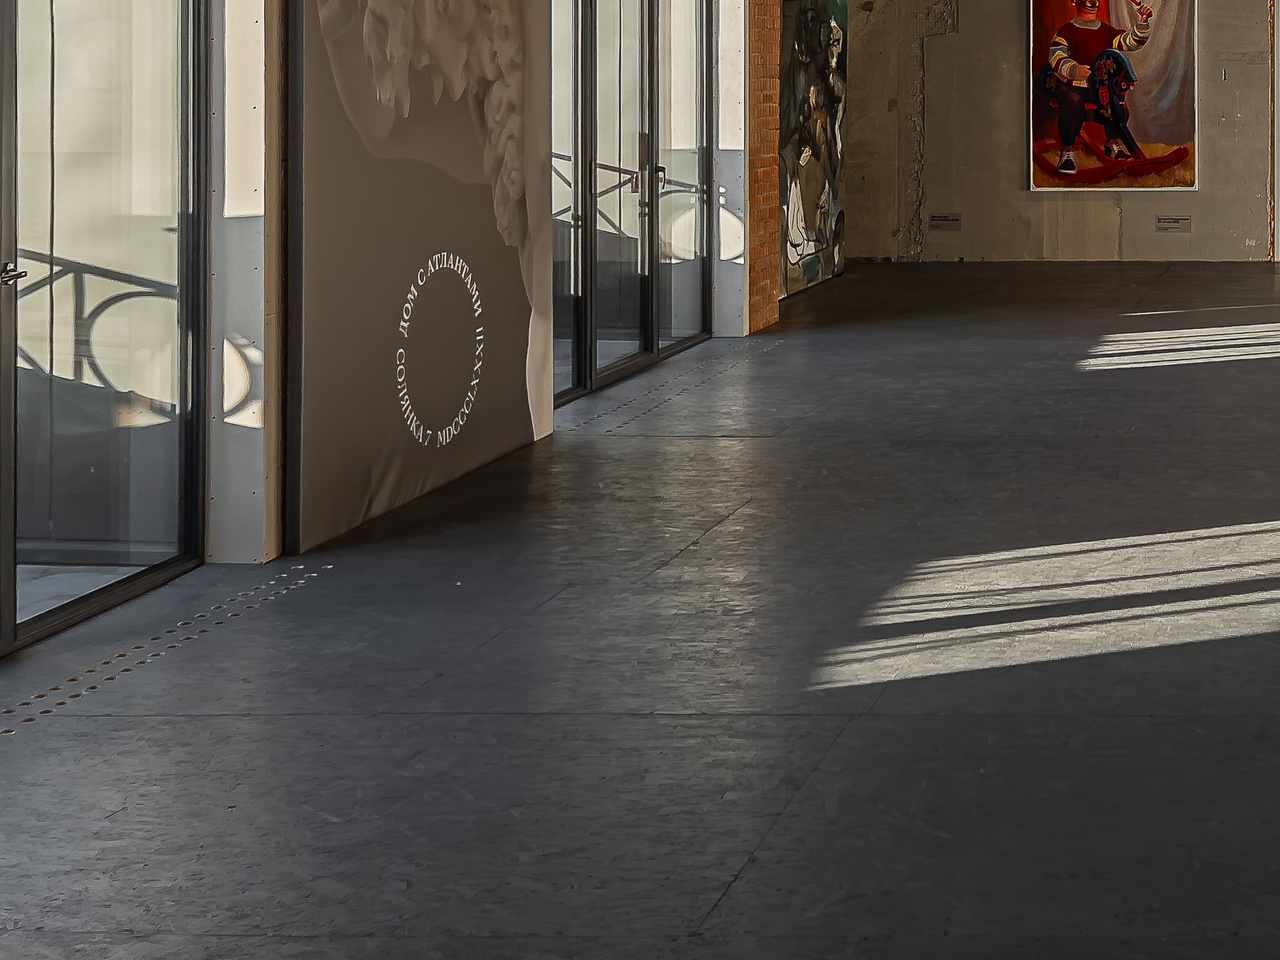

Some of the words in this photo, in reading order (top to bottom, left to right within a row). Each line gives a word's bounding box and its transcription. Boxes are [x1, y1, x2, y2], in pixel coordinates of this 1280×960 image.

[398, 283, 419, 338] ДОМ
[416, 268, 427, 286] С
[426, 251, 483, 318] АТЛАНТАМИ
